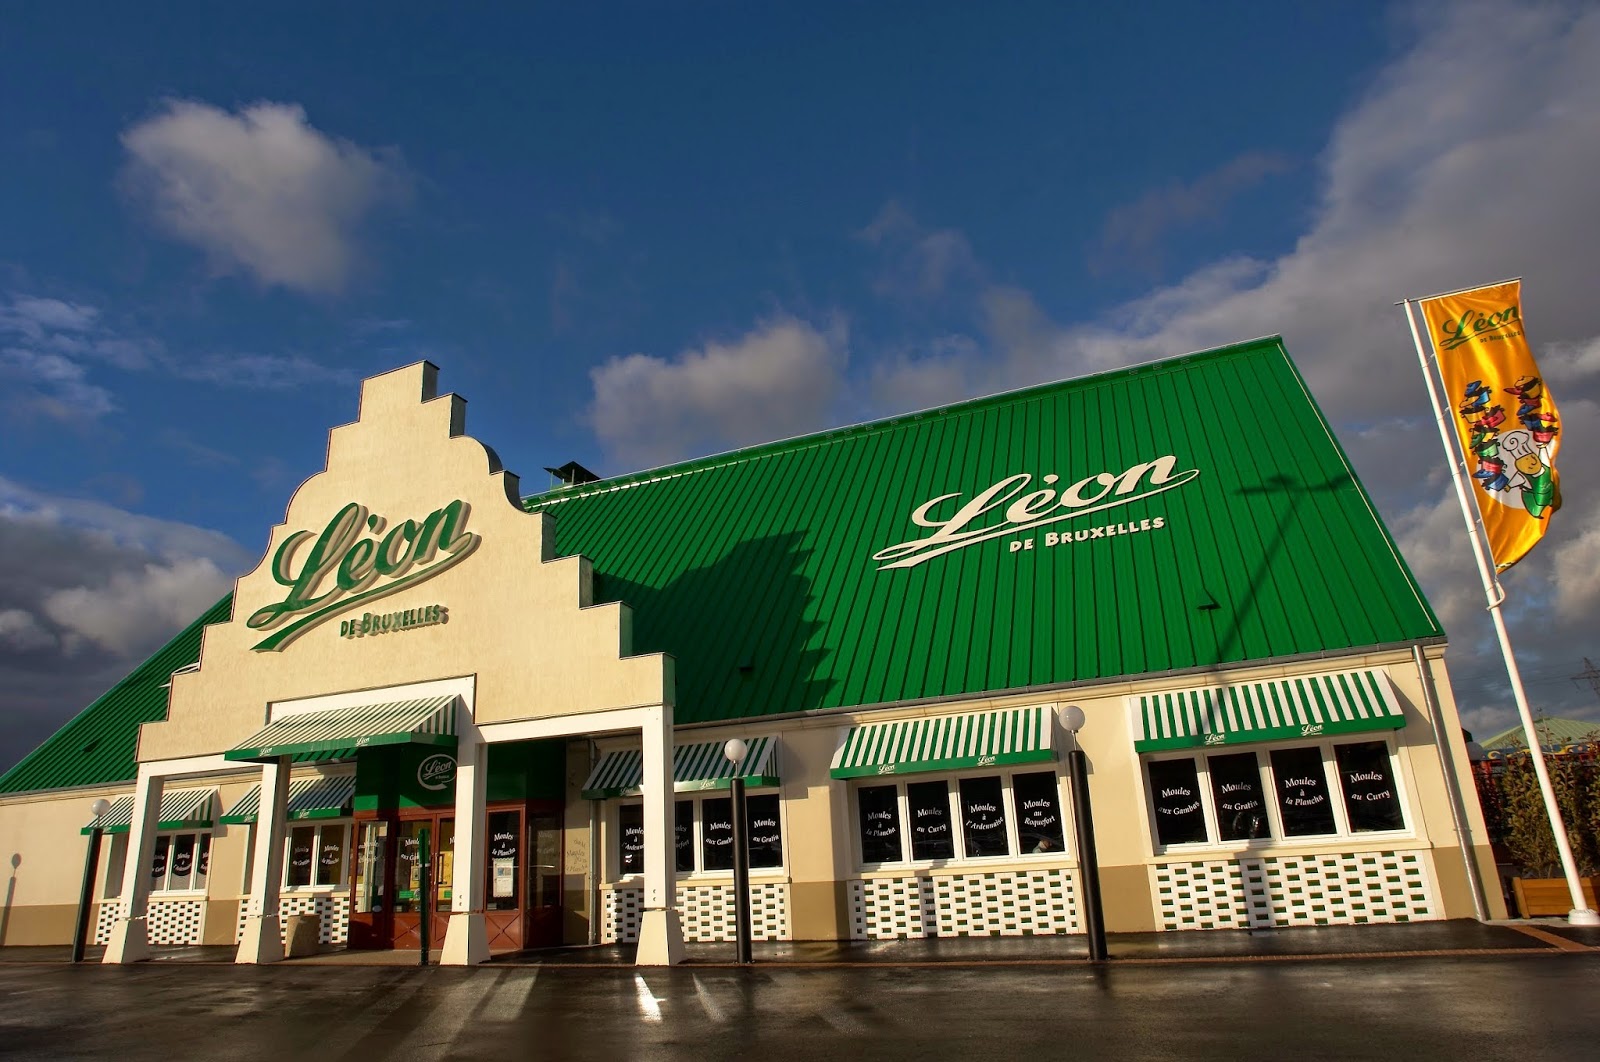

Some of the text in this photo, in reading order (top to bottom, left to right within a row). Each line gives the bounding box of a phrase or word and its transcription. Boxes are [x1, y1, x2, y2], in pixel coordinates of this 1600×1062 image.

[1439, 306, 1520, 347] Léon
[872, 455, 1199, 564] Léon
[247, 499, 482, 632] Léon
[1285, 777, 1316, 788] Moules
[1350, 771, 1382, 783] Moules
[1161, 787, 1191, 798] Moules
[1221, 782, 1251, 794] Moules
[1300, 788, 1305, 796] à
[1285, 794, 1324, 806] la Plancha
[1366, 789, 1391, 801] Curry
[970, 803, 996, 813] Moules
[1023, 798, 1051, 810] Moules
[1158, 800, 1200, 815] aux Gambas
[1234, 800, 1259, 811] Gratin
[867, 810, 892, 821] Moules
[917, 807, 943, 818] Moules
[709, 821, 732, 831] Moules
[753, 818, 777, 829] Moules
[1024, 815, 1056, 828] Roquefort
[873, 826, 896, 837] Plancha
[927, 823, 947, 834] Curry
[493, 832, 514, 842] Moules
[761, 834, 780, 843] Gratin
